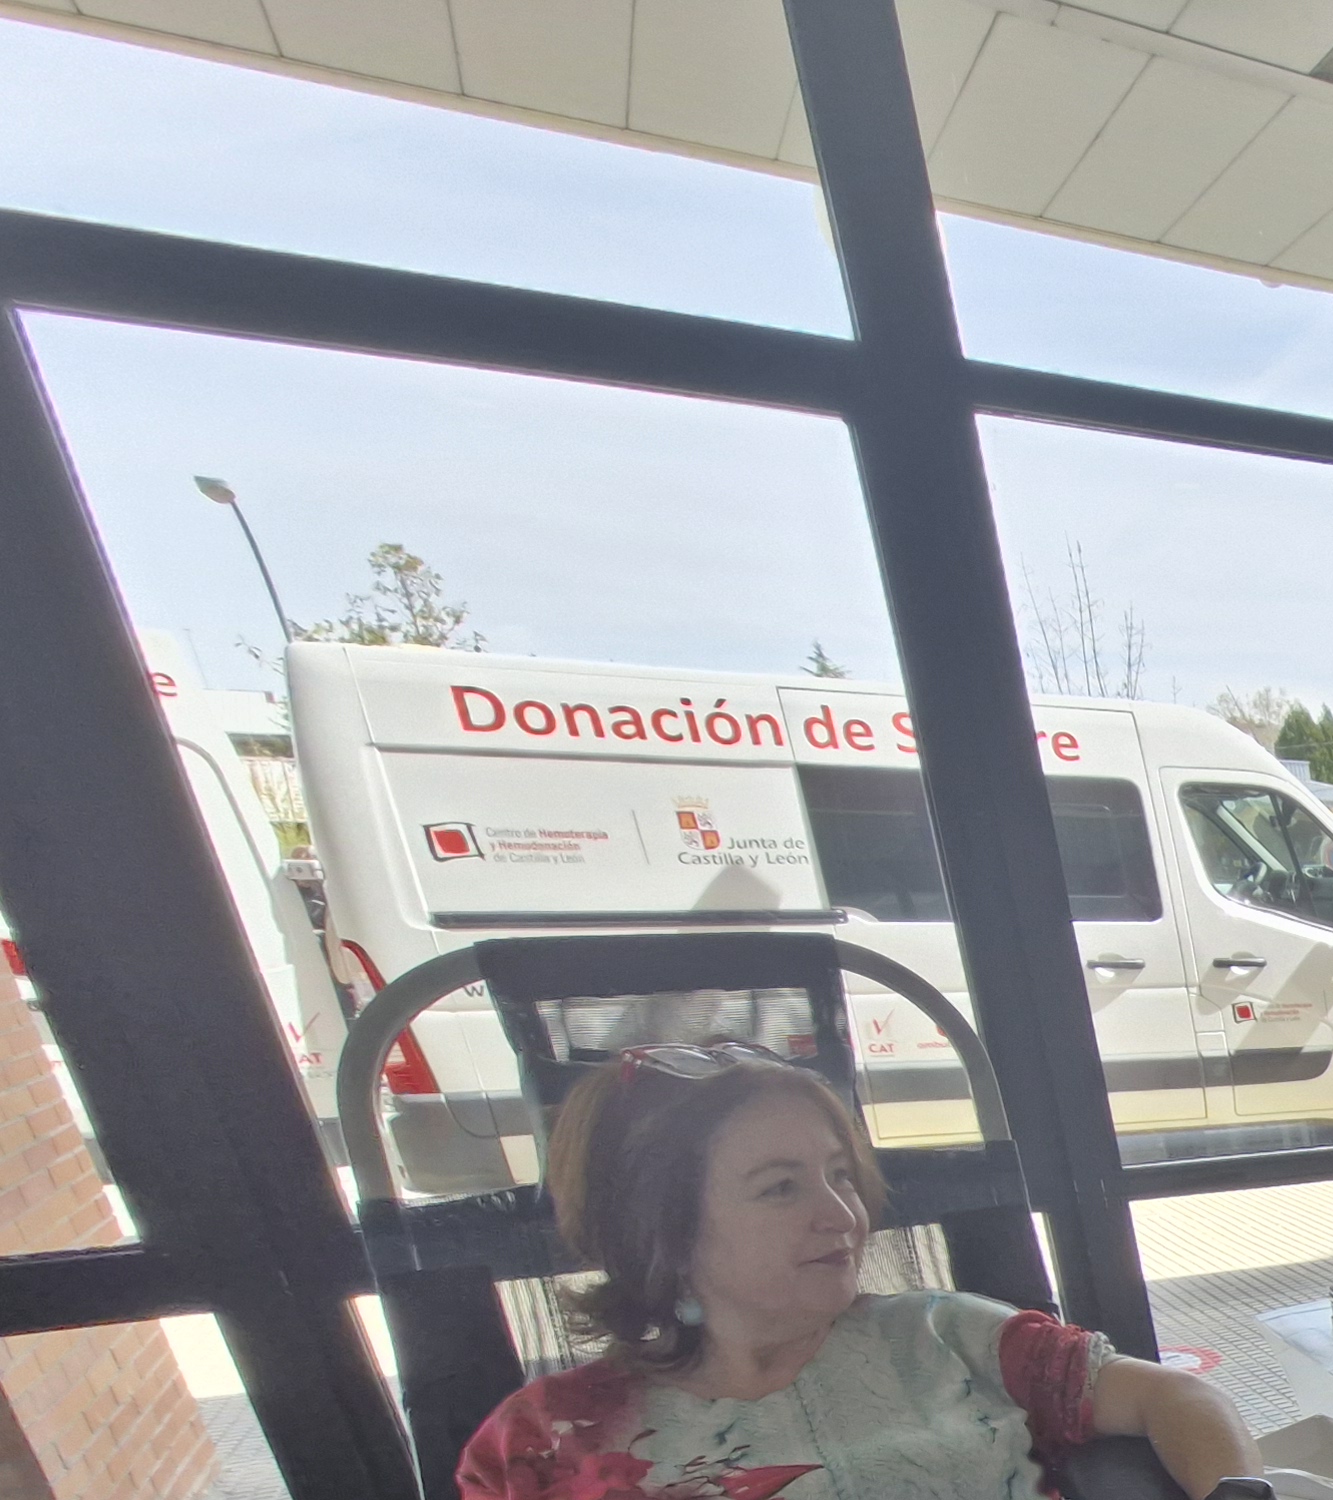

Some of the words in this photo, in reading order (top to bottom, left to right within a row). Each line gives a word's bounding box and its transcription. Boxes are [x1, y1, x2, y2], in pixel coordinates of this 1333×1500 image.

[449, 685, 785, 746] Donación
[803, 704, 876, 752] de
[485, 827, 522, 839] Centro
[523, 829, 537, 839] de
[538, 828, 609, 840] Hemoterapia
[498, 840, 582, 852] Hemodonación
[726, 836, 778, 850] Junta
[783, 837, 806, 850] de
[509, 853, 550, 863] Castilla
[560, 853, 585, 863] León
[677, 851, 745, 866] Castilla
[748, 854, 759, 868] y
[765, 851, 810, 866] León
[868, 1043, 895, 1053] CAT
